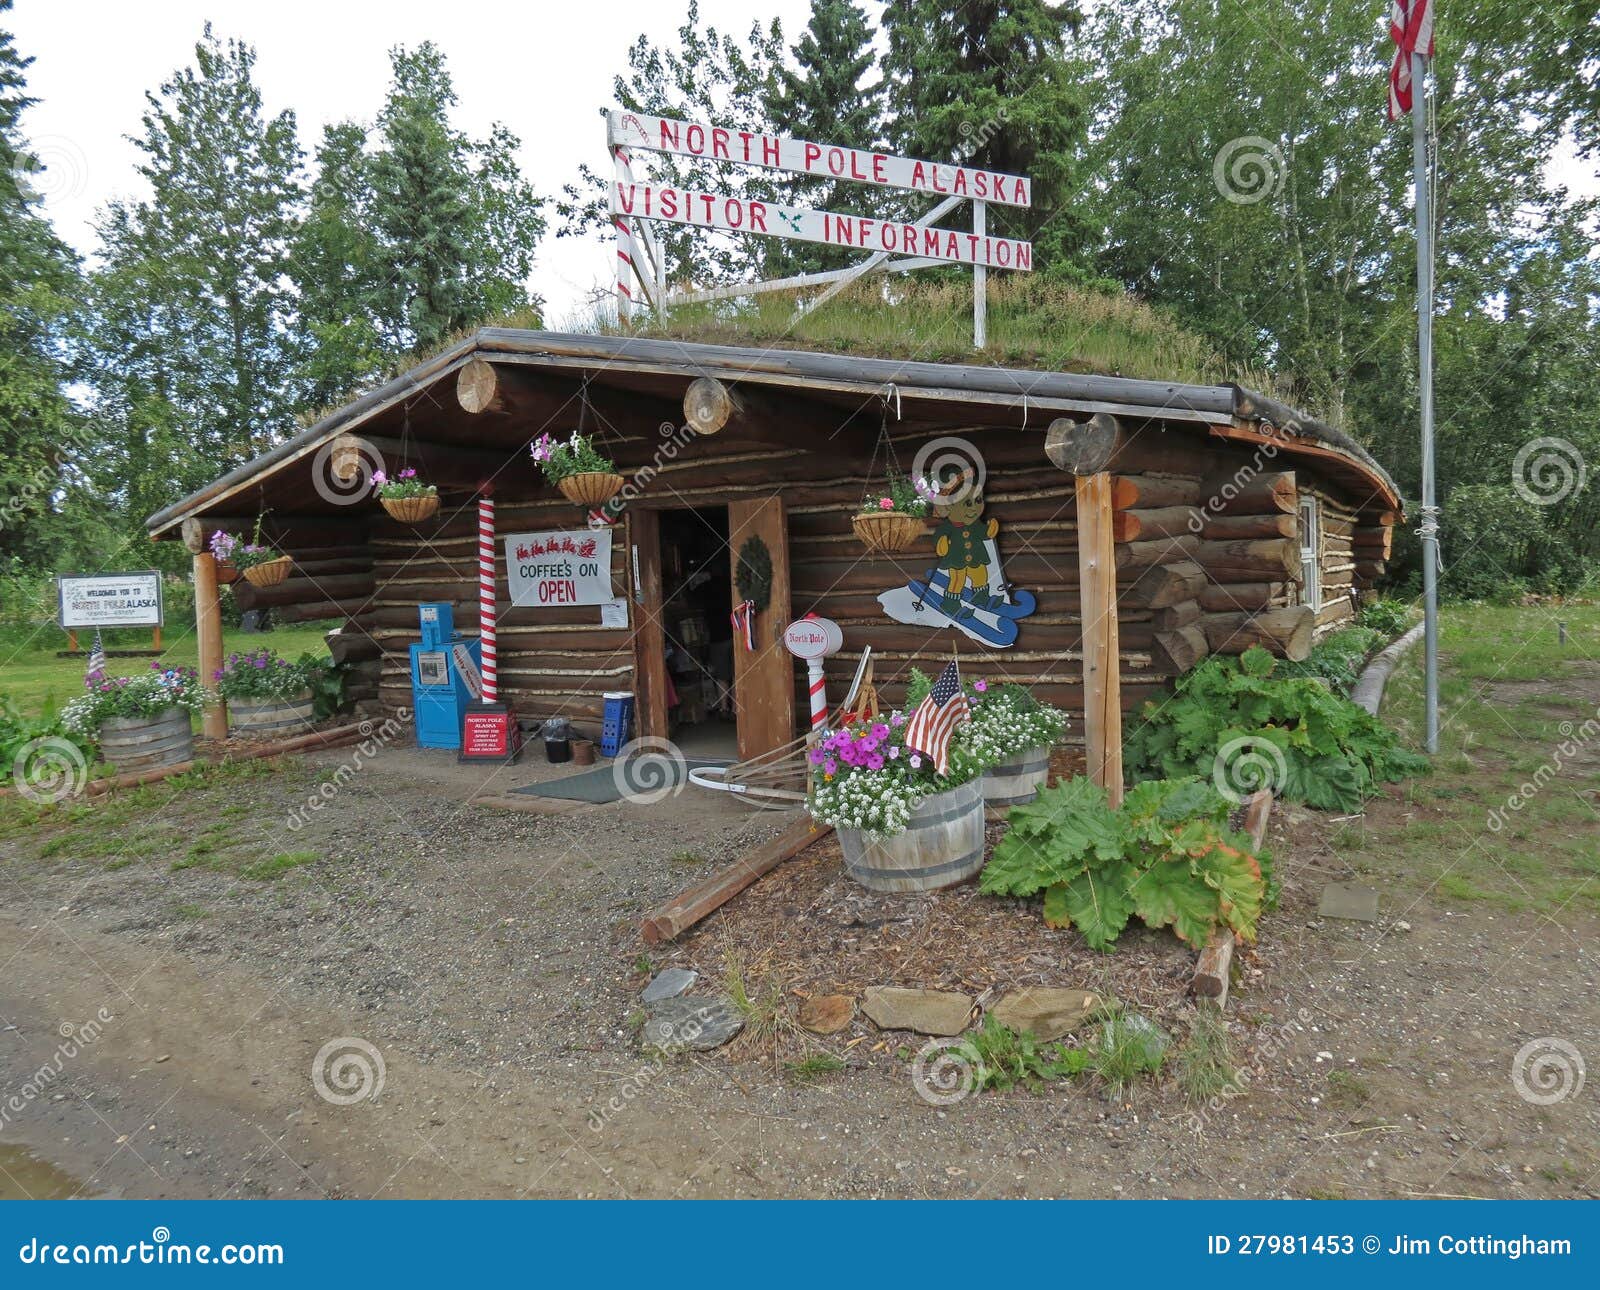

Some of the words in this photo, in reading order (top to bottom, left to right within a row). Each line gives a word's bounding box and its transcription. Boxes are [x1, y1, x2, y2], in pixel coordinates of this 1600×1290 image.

[660, 119, 780, 167] NORTH
[805, 143, 888, 183] POLE
[911, 161, 1027, 205] ALASKA
[617, 182, 768, 233] VISITOR
[824, 214, 1031, 269] INFORMATION
[520, 559, 572, 578] COFFEE'S
[579, 563, 598, 577] ON
[120, 588, 130, 596] YOU
[538, 580, 577, 603] OPEN
[126, 599, 157, 608] ALASKA
[789, 633, 808, 643] North
[809, 633, 825, 644] Pole
